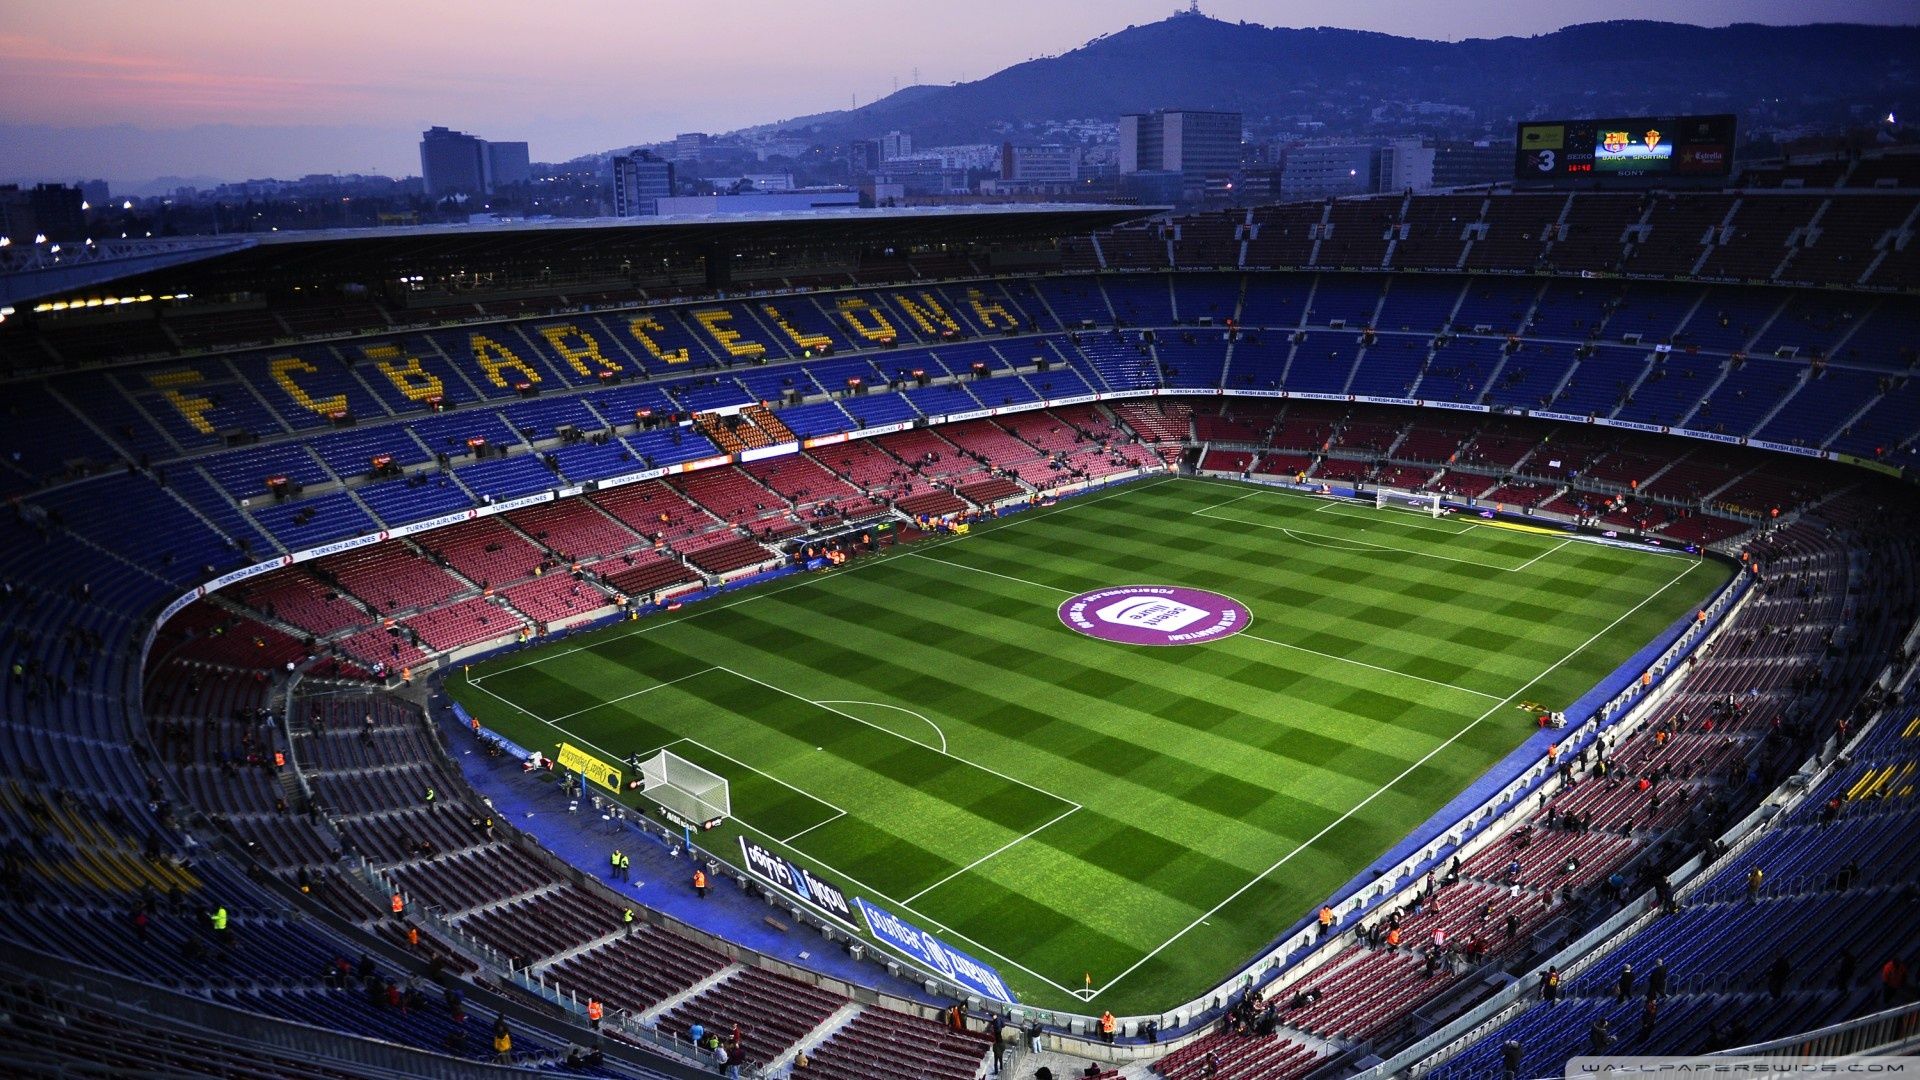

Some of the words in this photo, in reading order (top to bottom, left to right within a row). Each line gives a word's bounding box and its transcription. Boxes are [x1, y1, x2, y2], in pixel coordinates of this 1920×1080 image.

[1537, 150, 1555, 171] 3
[1695, 152, 1722, 160] Estrella
[360, 288, 1021, 403] BARCELONA
[952, 412, 970, 421] TURKISH
[969, 410, 990, 418] AIRLINES
[1006, 405, 1024, 413] TURKISH
[1024, 402, 1043, 410] AIRLINES
[856, 426, 879, 438] TURKISH
[878, 424, 897, 433] AIRLINES
[1608, 420, 1632, 428] TURKISH
[1632, 424, 1659, 432] AIRLINES
[1683, 430, 1709, 439] TURKISH
[1709, 434, 1736, 443] AIRLINES
[1762, 442, 1789, 451] TURKISH
[1789, 446, 1817, 456] AIRLINES
[610, 473, 634, 486] TURKISH
[635, 469, 660, 481] AIRLINES
[492, 500, 519, 513] TURKISH
[520, 494, 547, 507] AIRLINES
[405, 520, 436, 534] TURKISH
[436, 513, 465, 525] AIRLINES
[310, 542, 343, 557] TURKISH
[344, 535, 376, 549] AIRLINES
[1129, 603, 1170, 621] lliure
[1142, 606, 1187, 627] seient
[803, 869, 849, 914] mobily
[867, 907, 931, 961] Seguros
[945, 949, 1008, 1003] Allianz
